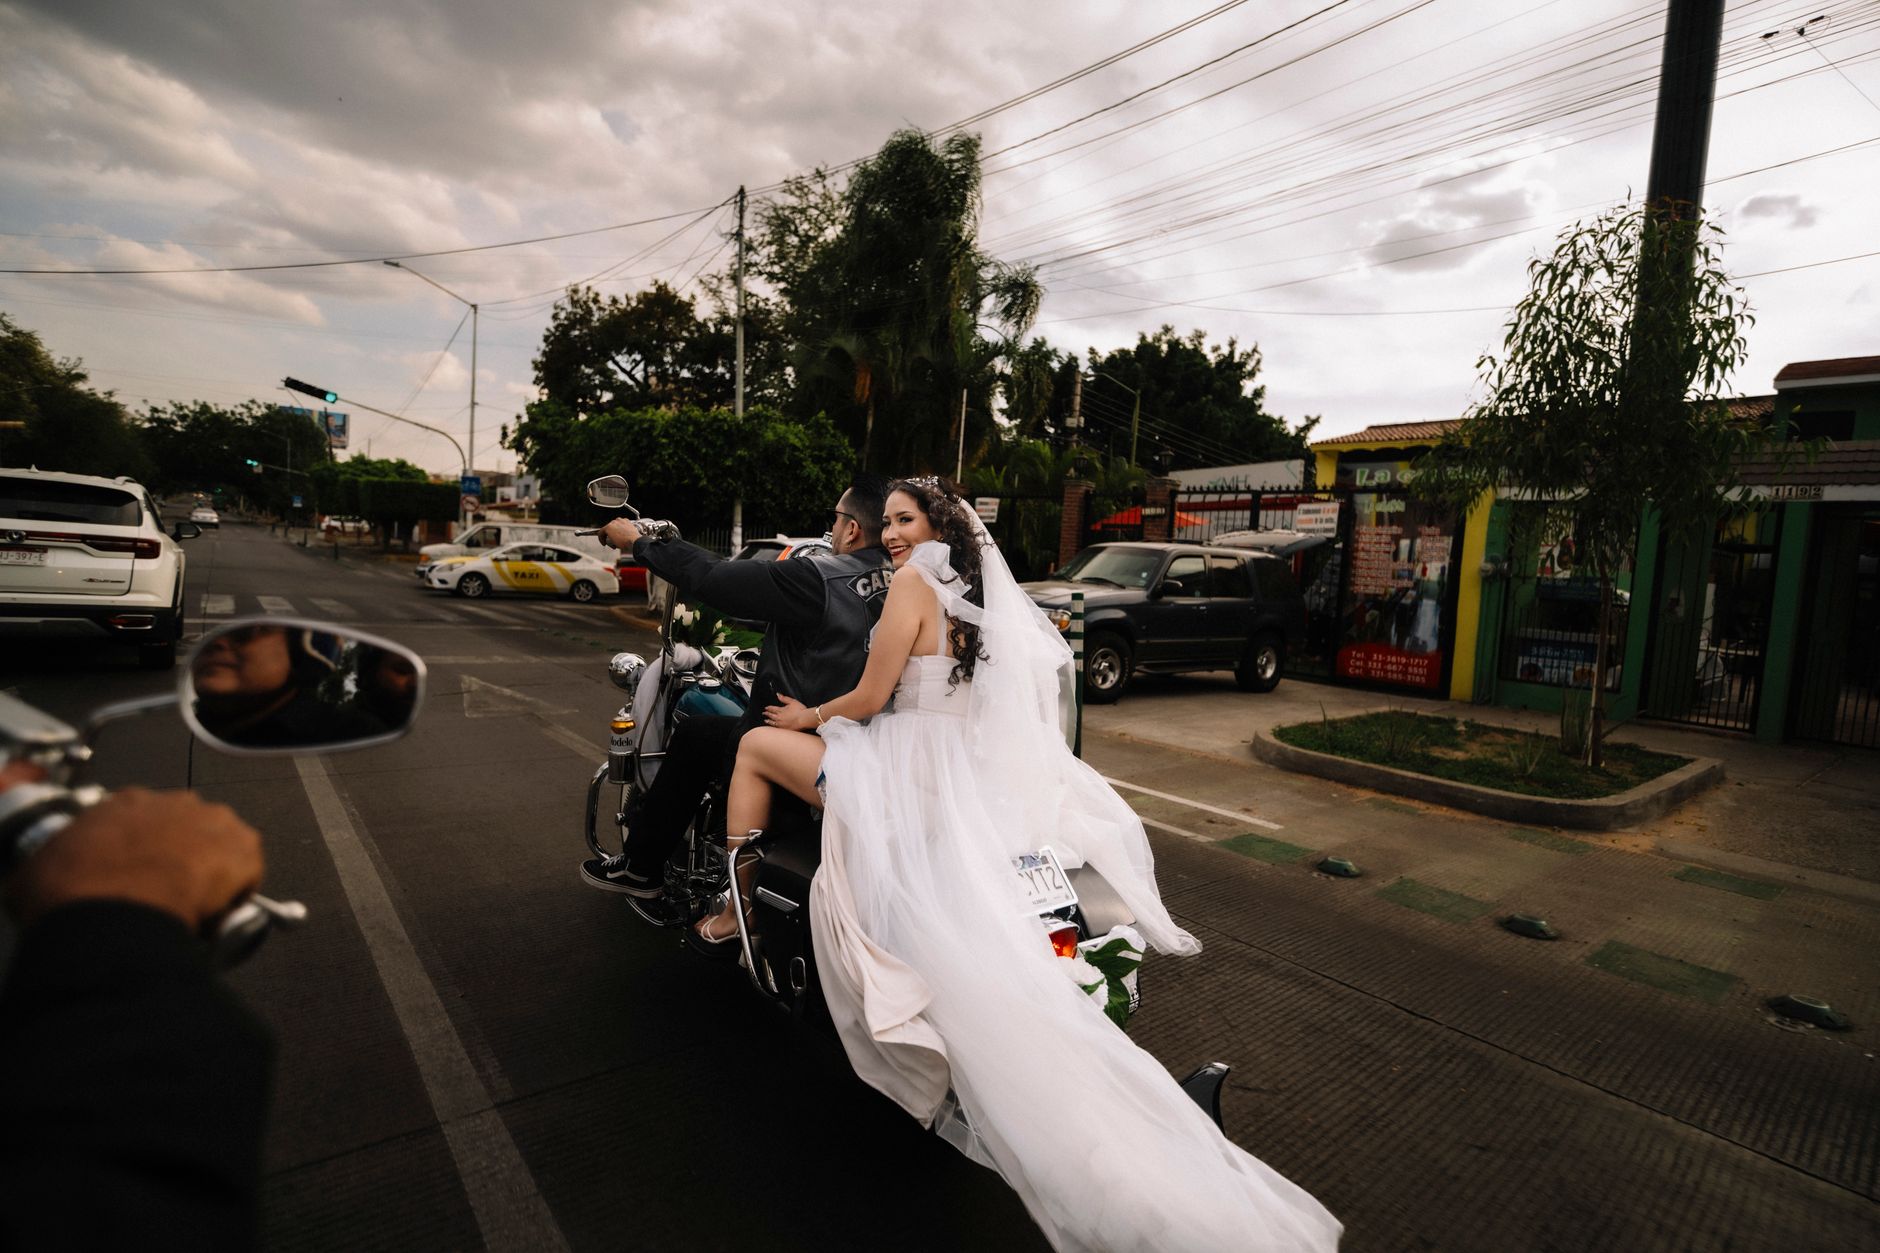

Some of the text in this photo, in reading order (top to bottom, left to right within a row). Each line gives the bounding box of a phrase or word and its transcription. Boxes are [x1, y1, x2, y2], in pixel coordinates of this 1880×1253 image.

[1355, 468, 1391, 487] La
[1775, 487, 1821, 496] 1192
[513, 571, 540, 579] TAXI
